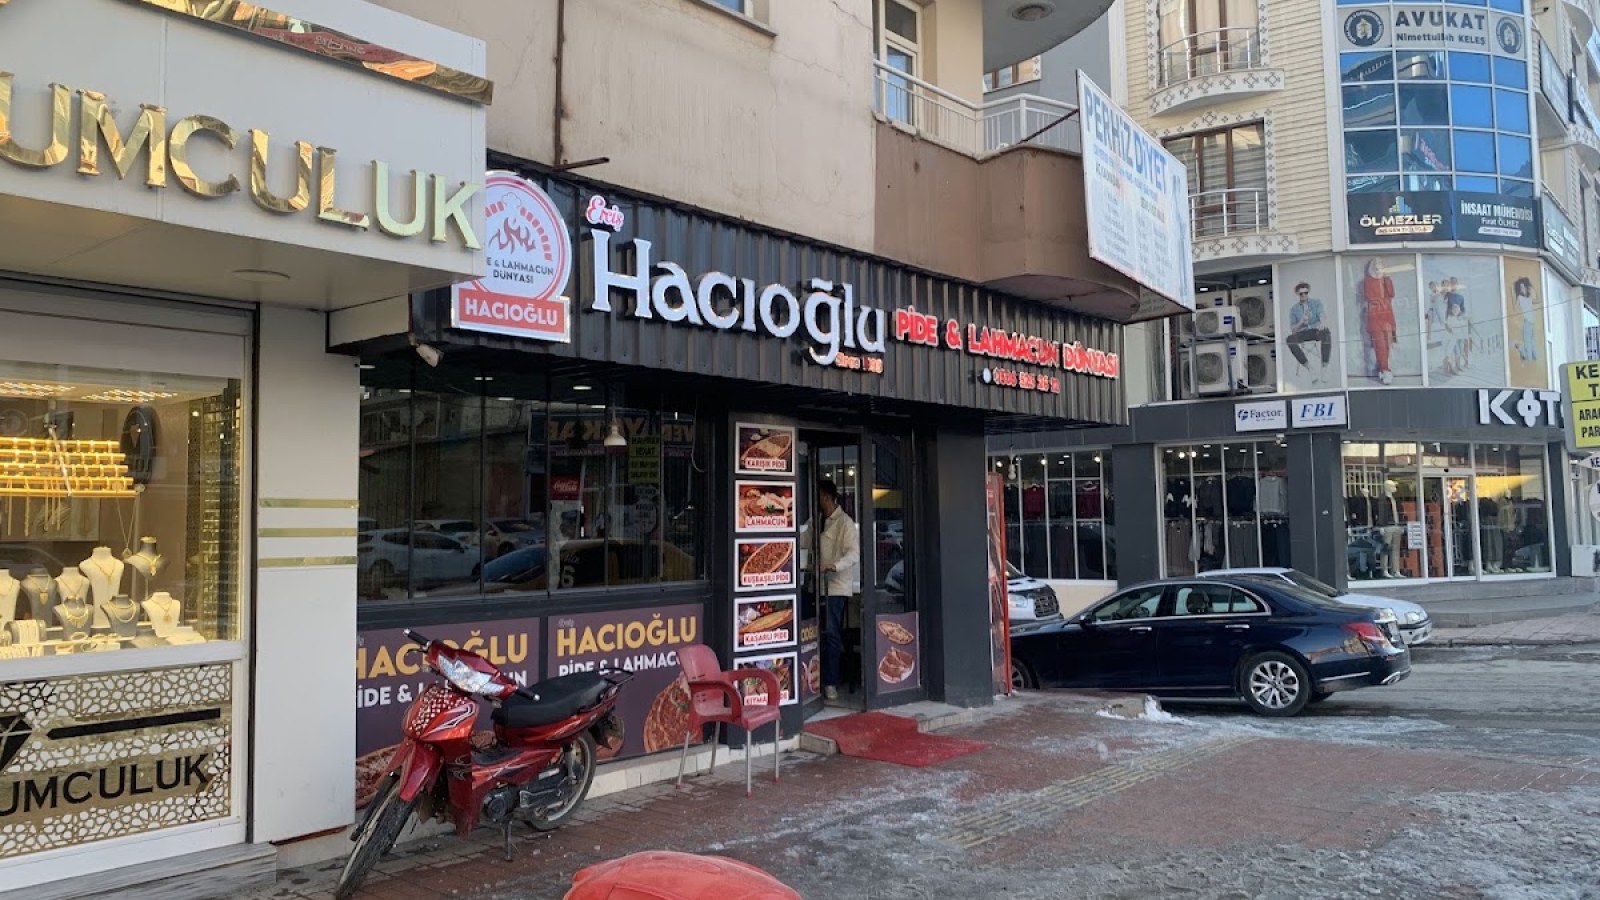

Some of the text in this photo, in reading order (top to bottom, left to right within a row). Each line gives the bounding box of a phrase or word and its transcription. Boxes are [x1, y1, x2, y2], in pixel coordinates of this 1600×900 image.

[1395, 11, 1485, 30] AVUKAT
[1084, 83, 1134, 169] PERHİZ
[1132, 129, 1169, 195] DİYET
[0, 71, 482, 249] UMCULUK
[1360, 213, 1442, 227] ÖLMEZLER
[493, 269, 534, 284] DÜNYASI
[502, 259, 554, 276] LAHMACUN
[591, 228, 886, 365] Hacıoğlu
[464, 297, 558, 327] HACIOĞLU
[896, 306, 1119, 379] PİDE & LAHMACUN DÜNYASI
[1588, 383, 1600, 397] T
[1301, 402, 1334, 418] FBI
[1479, 388, 1564, 428] KOT
[1579, 408, 1600, 421] ARA
[746, 516, 787, 527] LAHMACUN
[557, 613, 697, 656] HACIOĞLU
[614, 650, 681, 675] LAHMAC
[397, 684, 413, 703] &
[0, 753, 212, 817] UMCULUK
